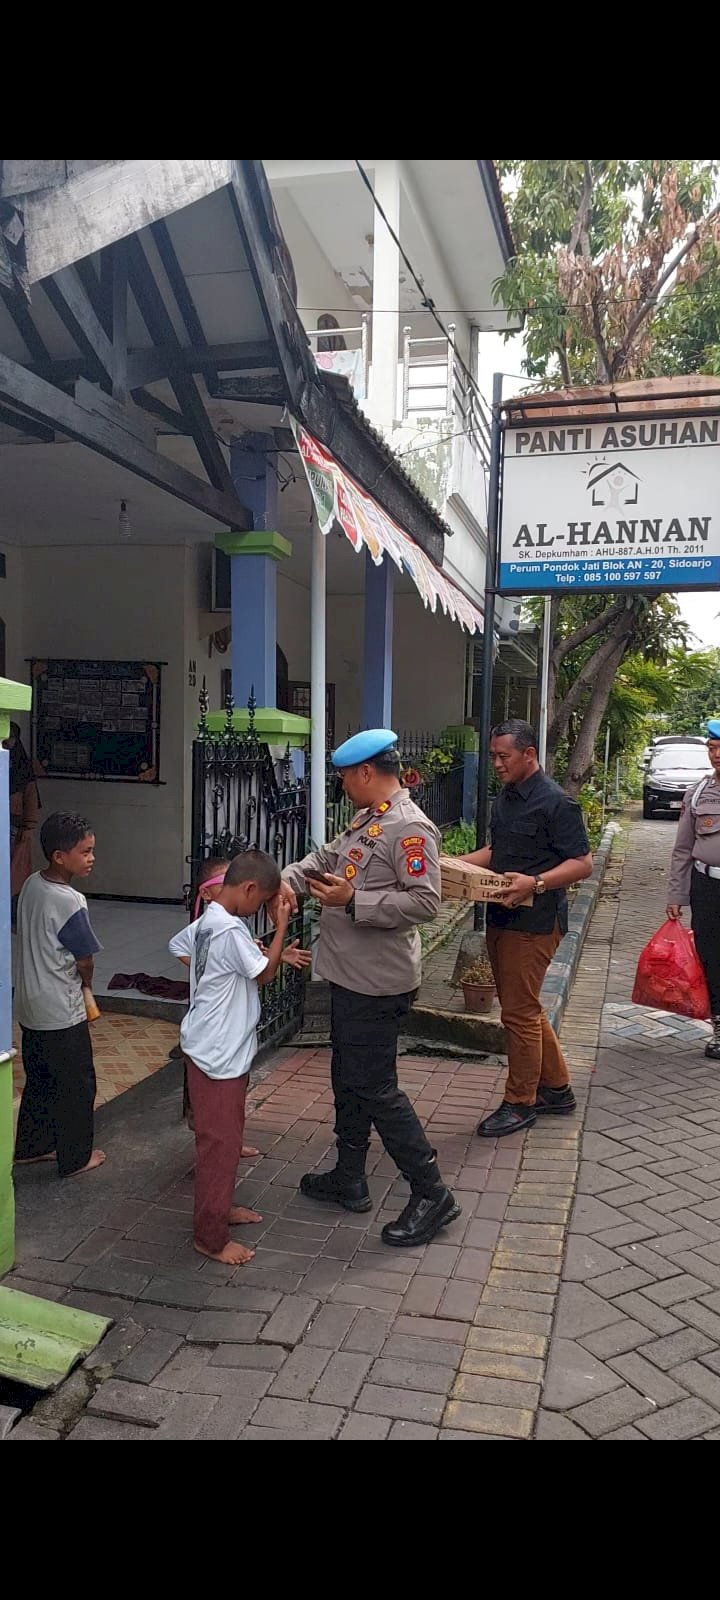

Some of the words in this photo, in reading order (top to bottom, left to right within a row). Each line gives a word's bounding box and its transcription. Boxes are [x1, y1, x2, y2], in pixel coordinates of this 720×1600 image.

[515, 428, 592, 454] PANTI
[601, 420, 719, 449] ASUHAN
[512, 516, 712, 547] AL-HANNAN
[518, 550, 533, 559] SK.
[535, 549, 588, 560] Depkumham
[595, 546, 664, 556] AHU-887.A.H.01
[668, 545, 681, 554] Th.
[684, 545, 704, 553] 2011
[510, 564, 541, 573] Perum
[543, 563, 580, 572] Pondok
[582, 562, 600, 571] Jati
[602, 561, 625, 570] Blok
[627, 561, 642, 569] AN
[651, 560, 666, 569] 20,
[669, 559, 712, 569] Sidoarjo
[555, 573, 575, 584] Telp
[584, 573, 601, 582] 085
[604, 573, 621, 581] 100
[623, 572, 641, 581] 597
[643, 571, 661, 580] 597
[480, 879, 500, 887] LIMO
